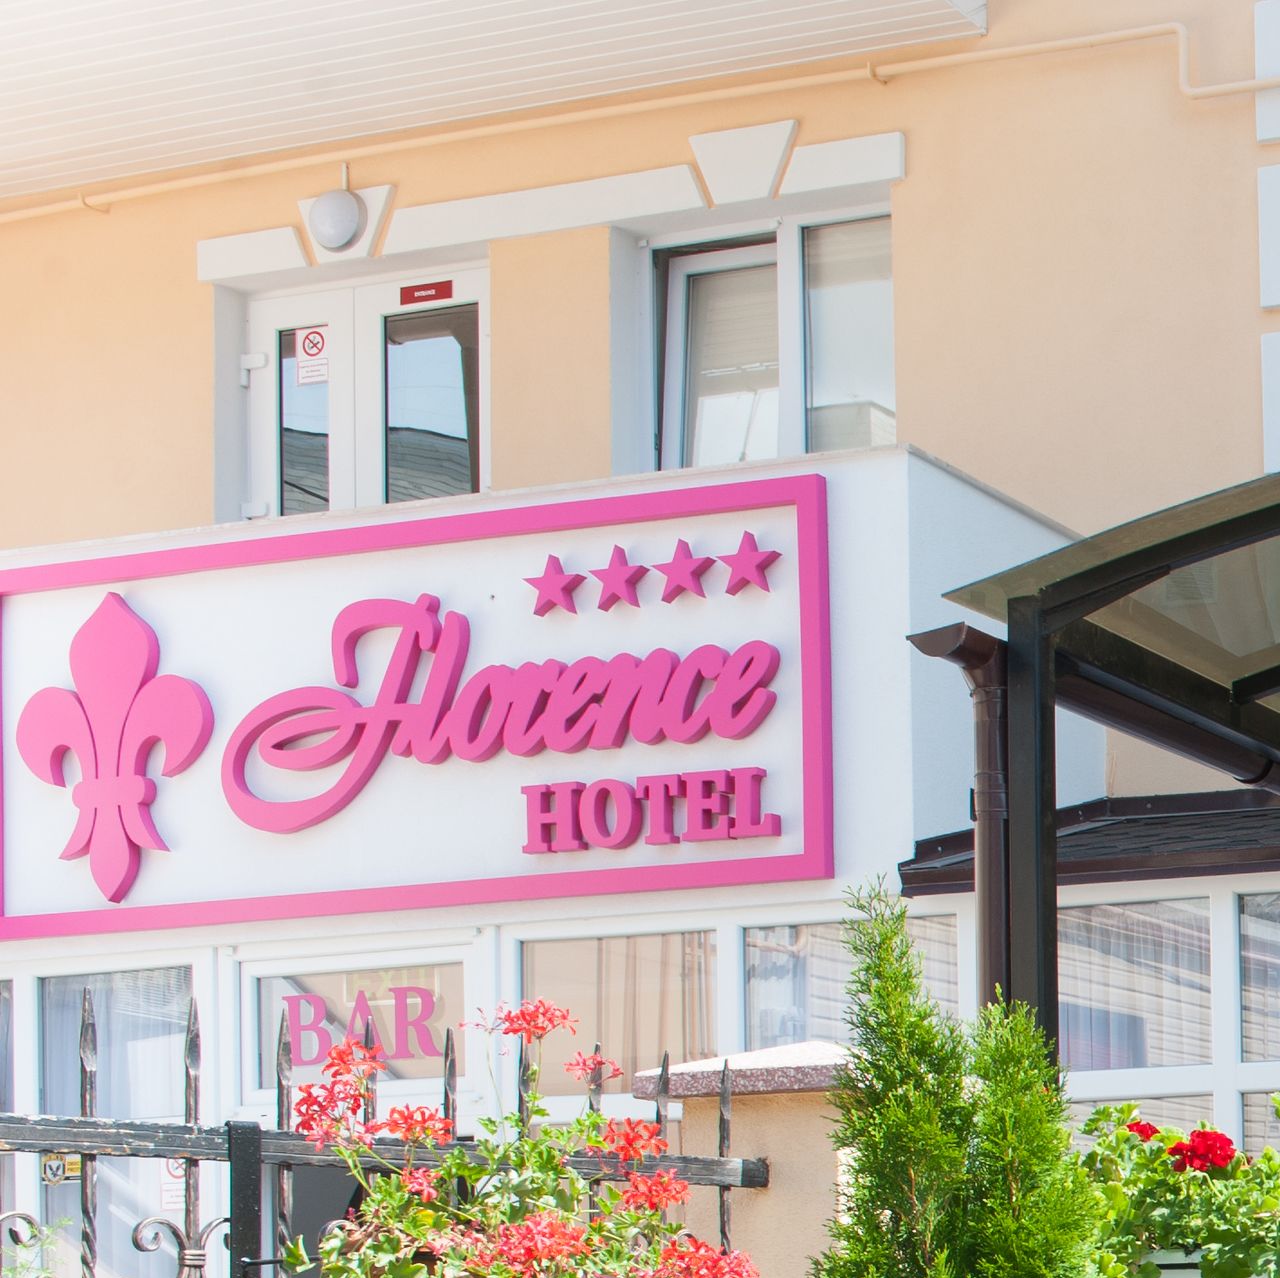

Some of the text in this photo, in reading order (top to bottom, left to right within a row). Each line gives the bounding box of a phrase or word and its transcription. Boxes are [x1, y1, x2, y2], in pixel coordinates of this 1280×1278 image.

[221, 593, 781, 835] Florence
[521, 766, 782, 855] HOTEL
[282, 985, 444, 1067] BAR
